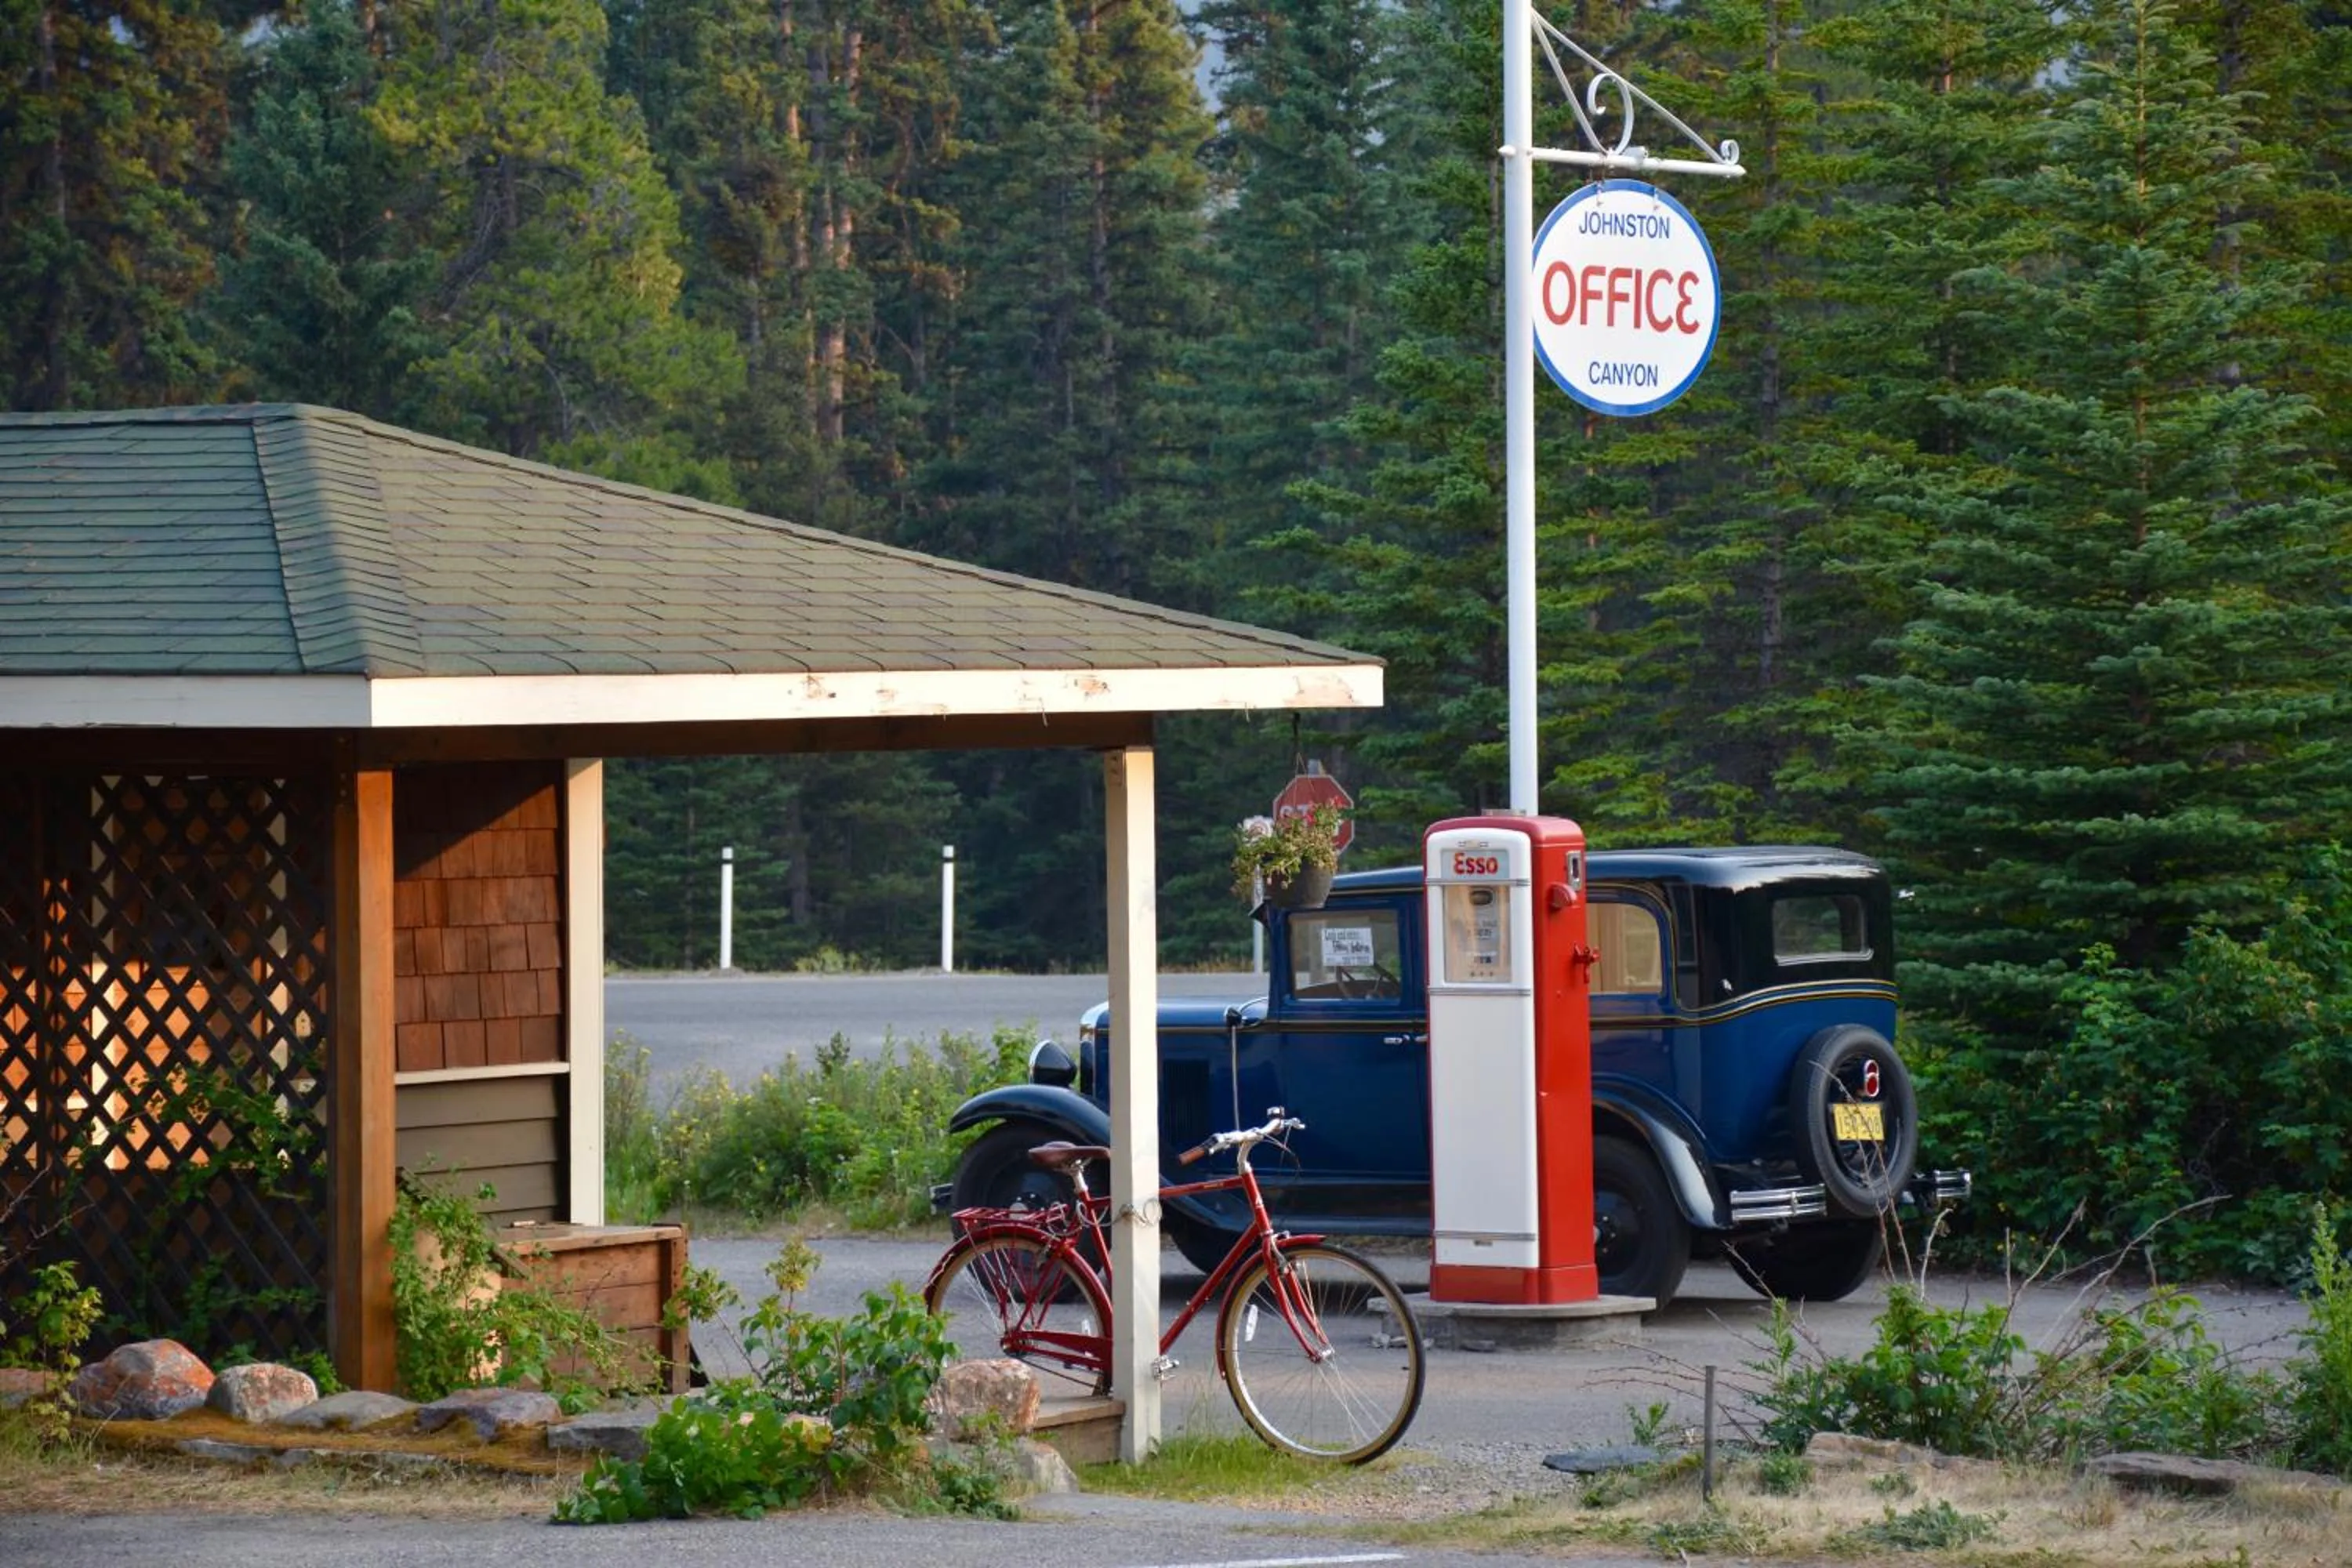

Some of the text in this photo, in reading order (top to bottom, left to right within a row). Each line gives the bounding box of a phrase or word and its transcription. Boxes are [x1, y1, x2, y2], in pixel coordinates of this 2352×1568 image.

[1579, 211, 1670, 239] JOHNSTON
[1542, 260, 1700, 335] OFFICE
[1588, 361, 1658, 387] CANYON
